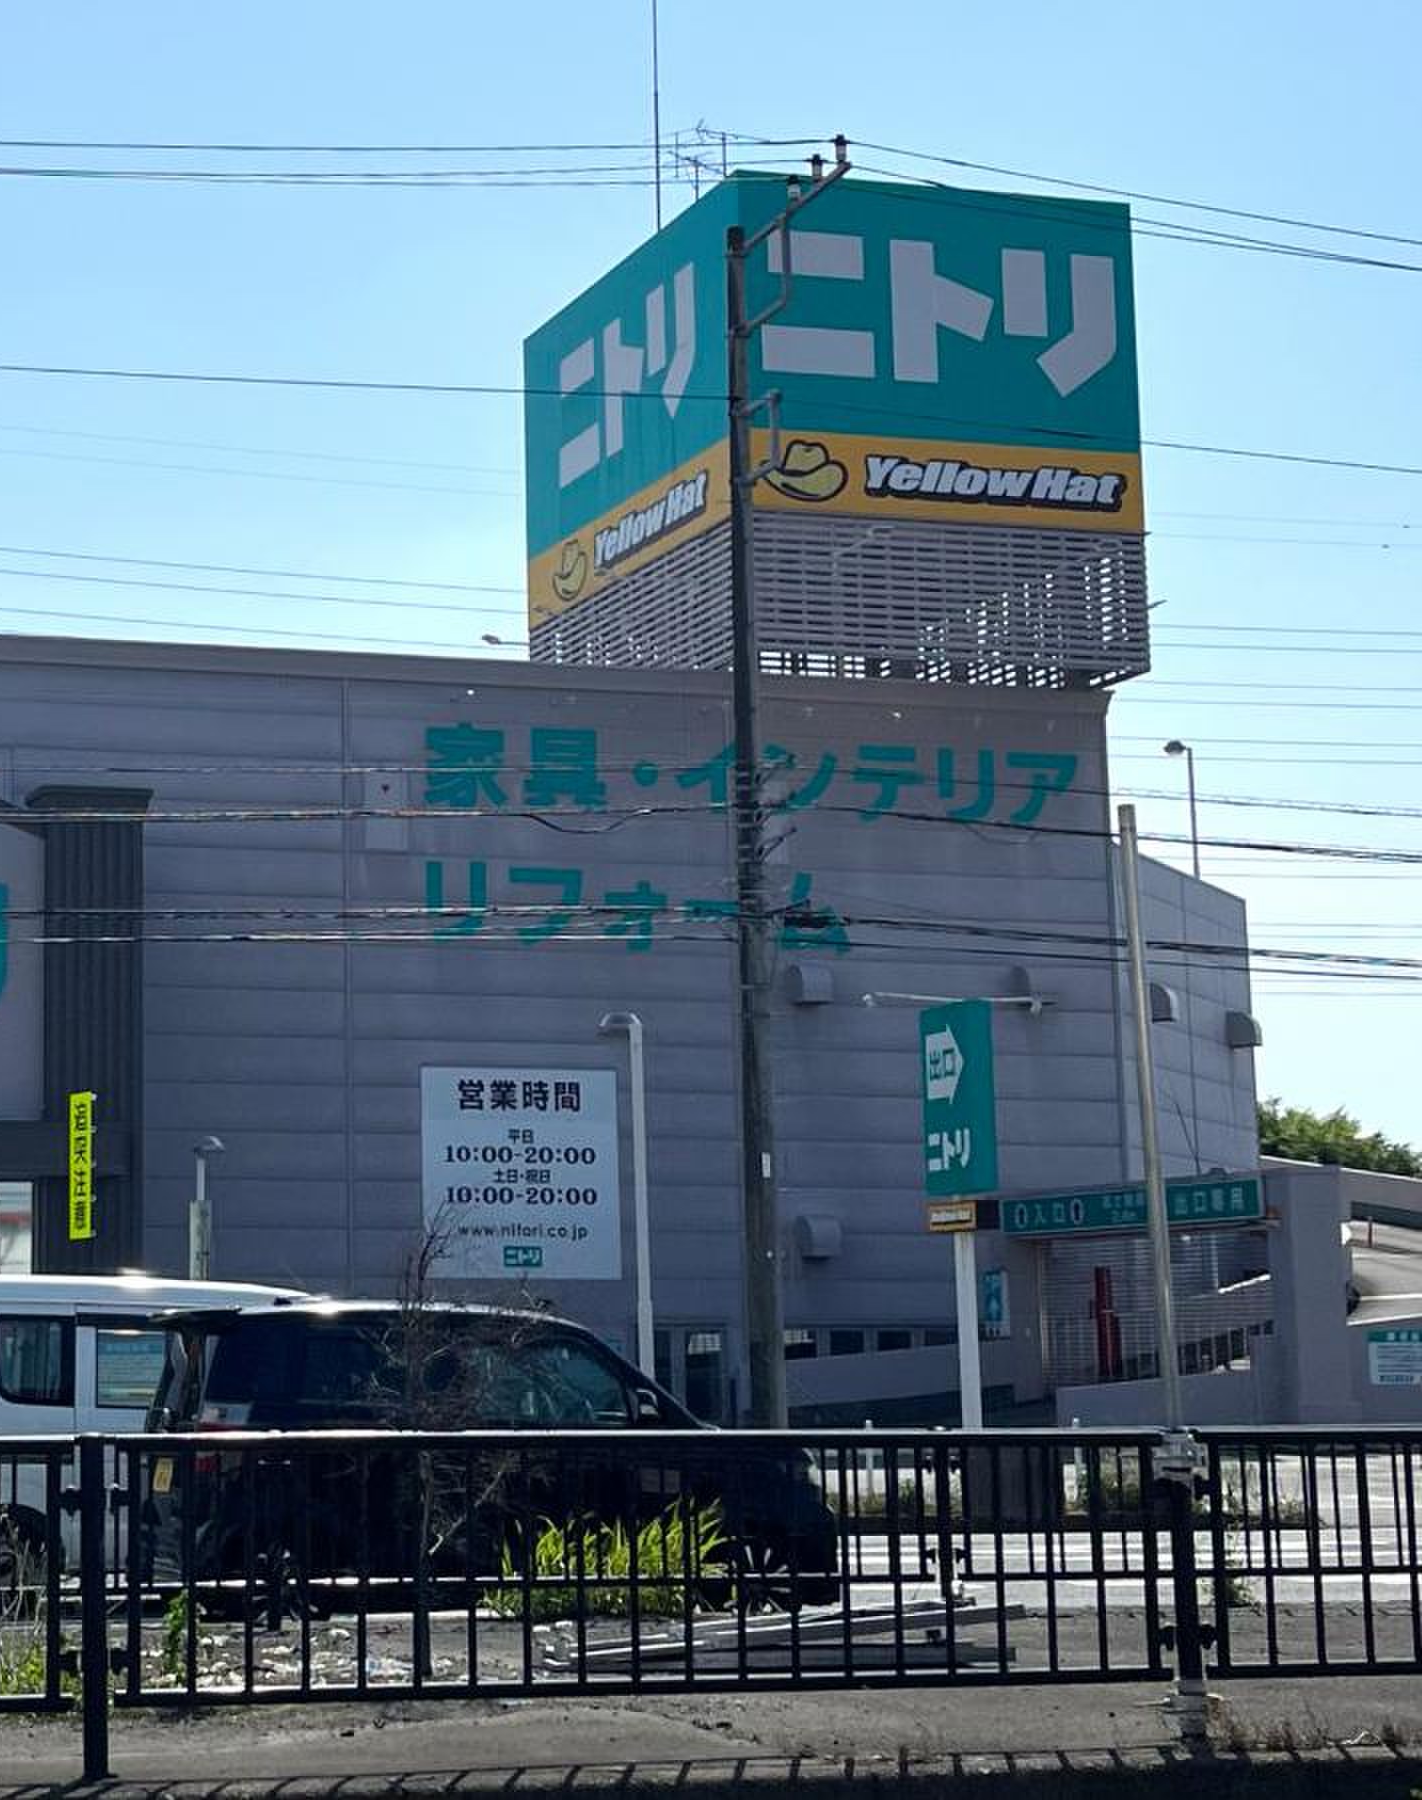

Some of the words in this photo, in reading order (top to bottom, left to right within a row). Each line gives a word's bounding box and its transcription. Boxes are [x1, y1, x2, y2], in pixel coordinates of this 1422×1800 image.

[762, 229, 1117, 398] ニトリ
[559, 262, 695, 489] ニトリ
[424, 722, 1078, 824] 家具・インテリア
[457, 1079, 581, 1112] 営業時間
[445, 1146, 596, 1165] 10:00-20:00
[508, 1129, 534, 1144] 平日
[928, 1126, 970, 1173] ニトリ
[447, 1186, 598, 1206] 10:00-20:00
